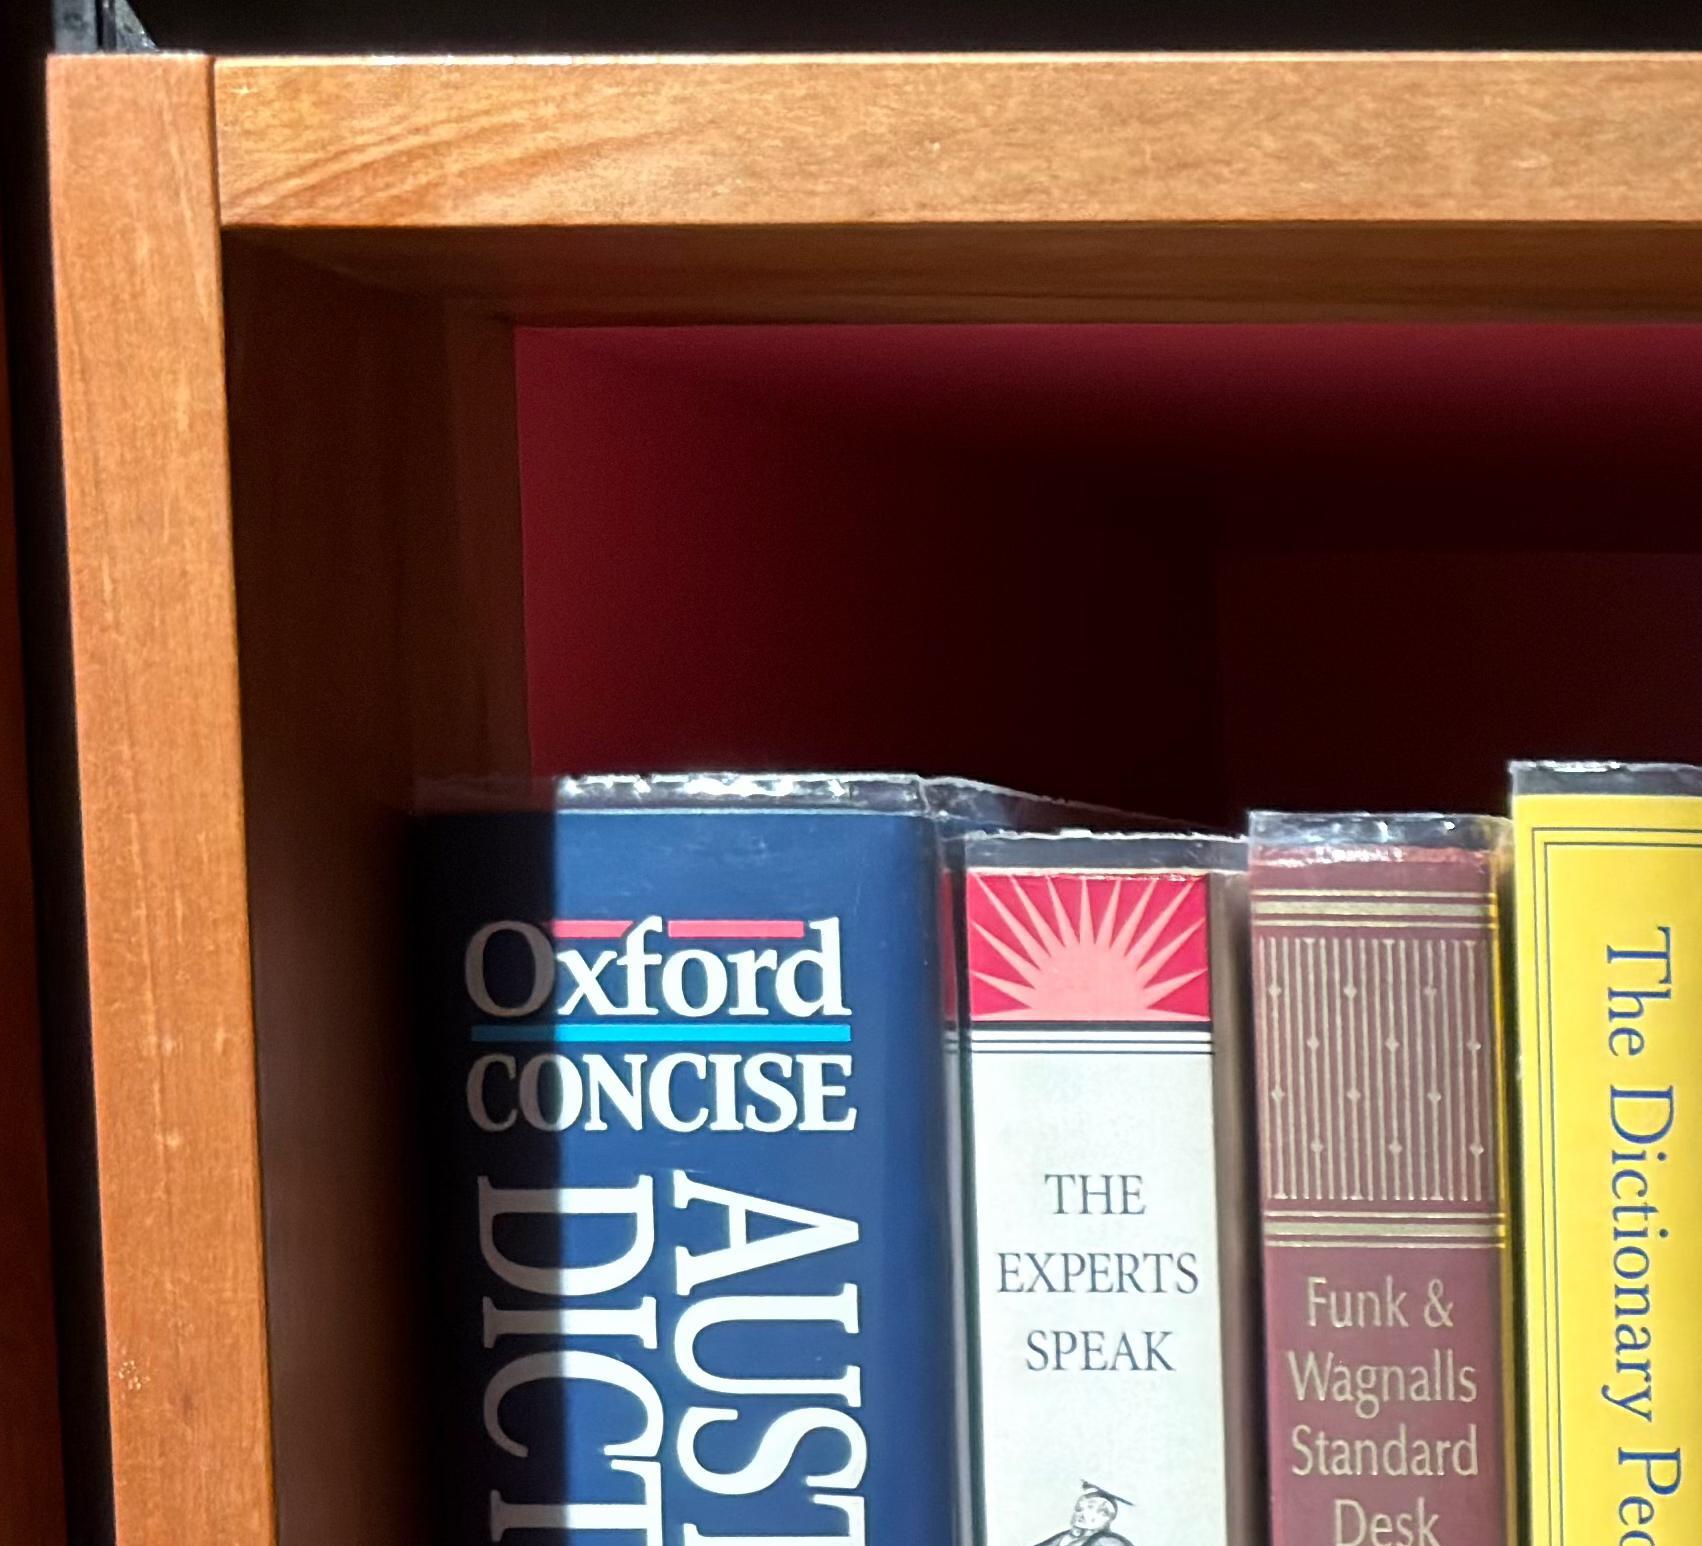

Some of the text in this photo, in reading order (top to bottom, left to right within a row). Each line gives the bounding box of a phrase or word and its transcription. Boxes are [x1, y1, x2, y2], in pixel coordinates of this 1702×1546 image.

[465, 918, 851, 1017] Oxford
[1605, 926, 1671, 1057] The
[467, 1053, 856, 1133] CONCISE
[1045, 1173, 1145, 1216] THE
[998, 1251, 1199, 1295] EXPERTS
[1602, 1086, 1674, 1423] Dictionary
[1307, 1275, 1453, 1328] Funk &
[1024, 1330, 1175, 1373] SPEAK
[1287, 1349, 1478, 1419] Wagnalls
[1291, 1423, 1478, 1477] Standard
